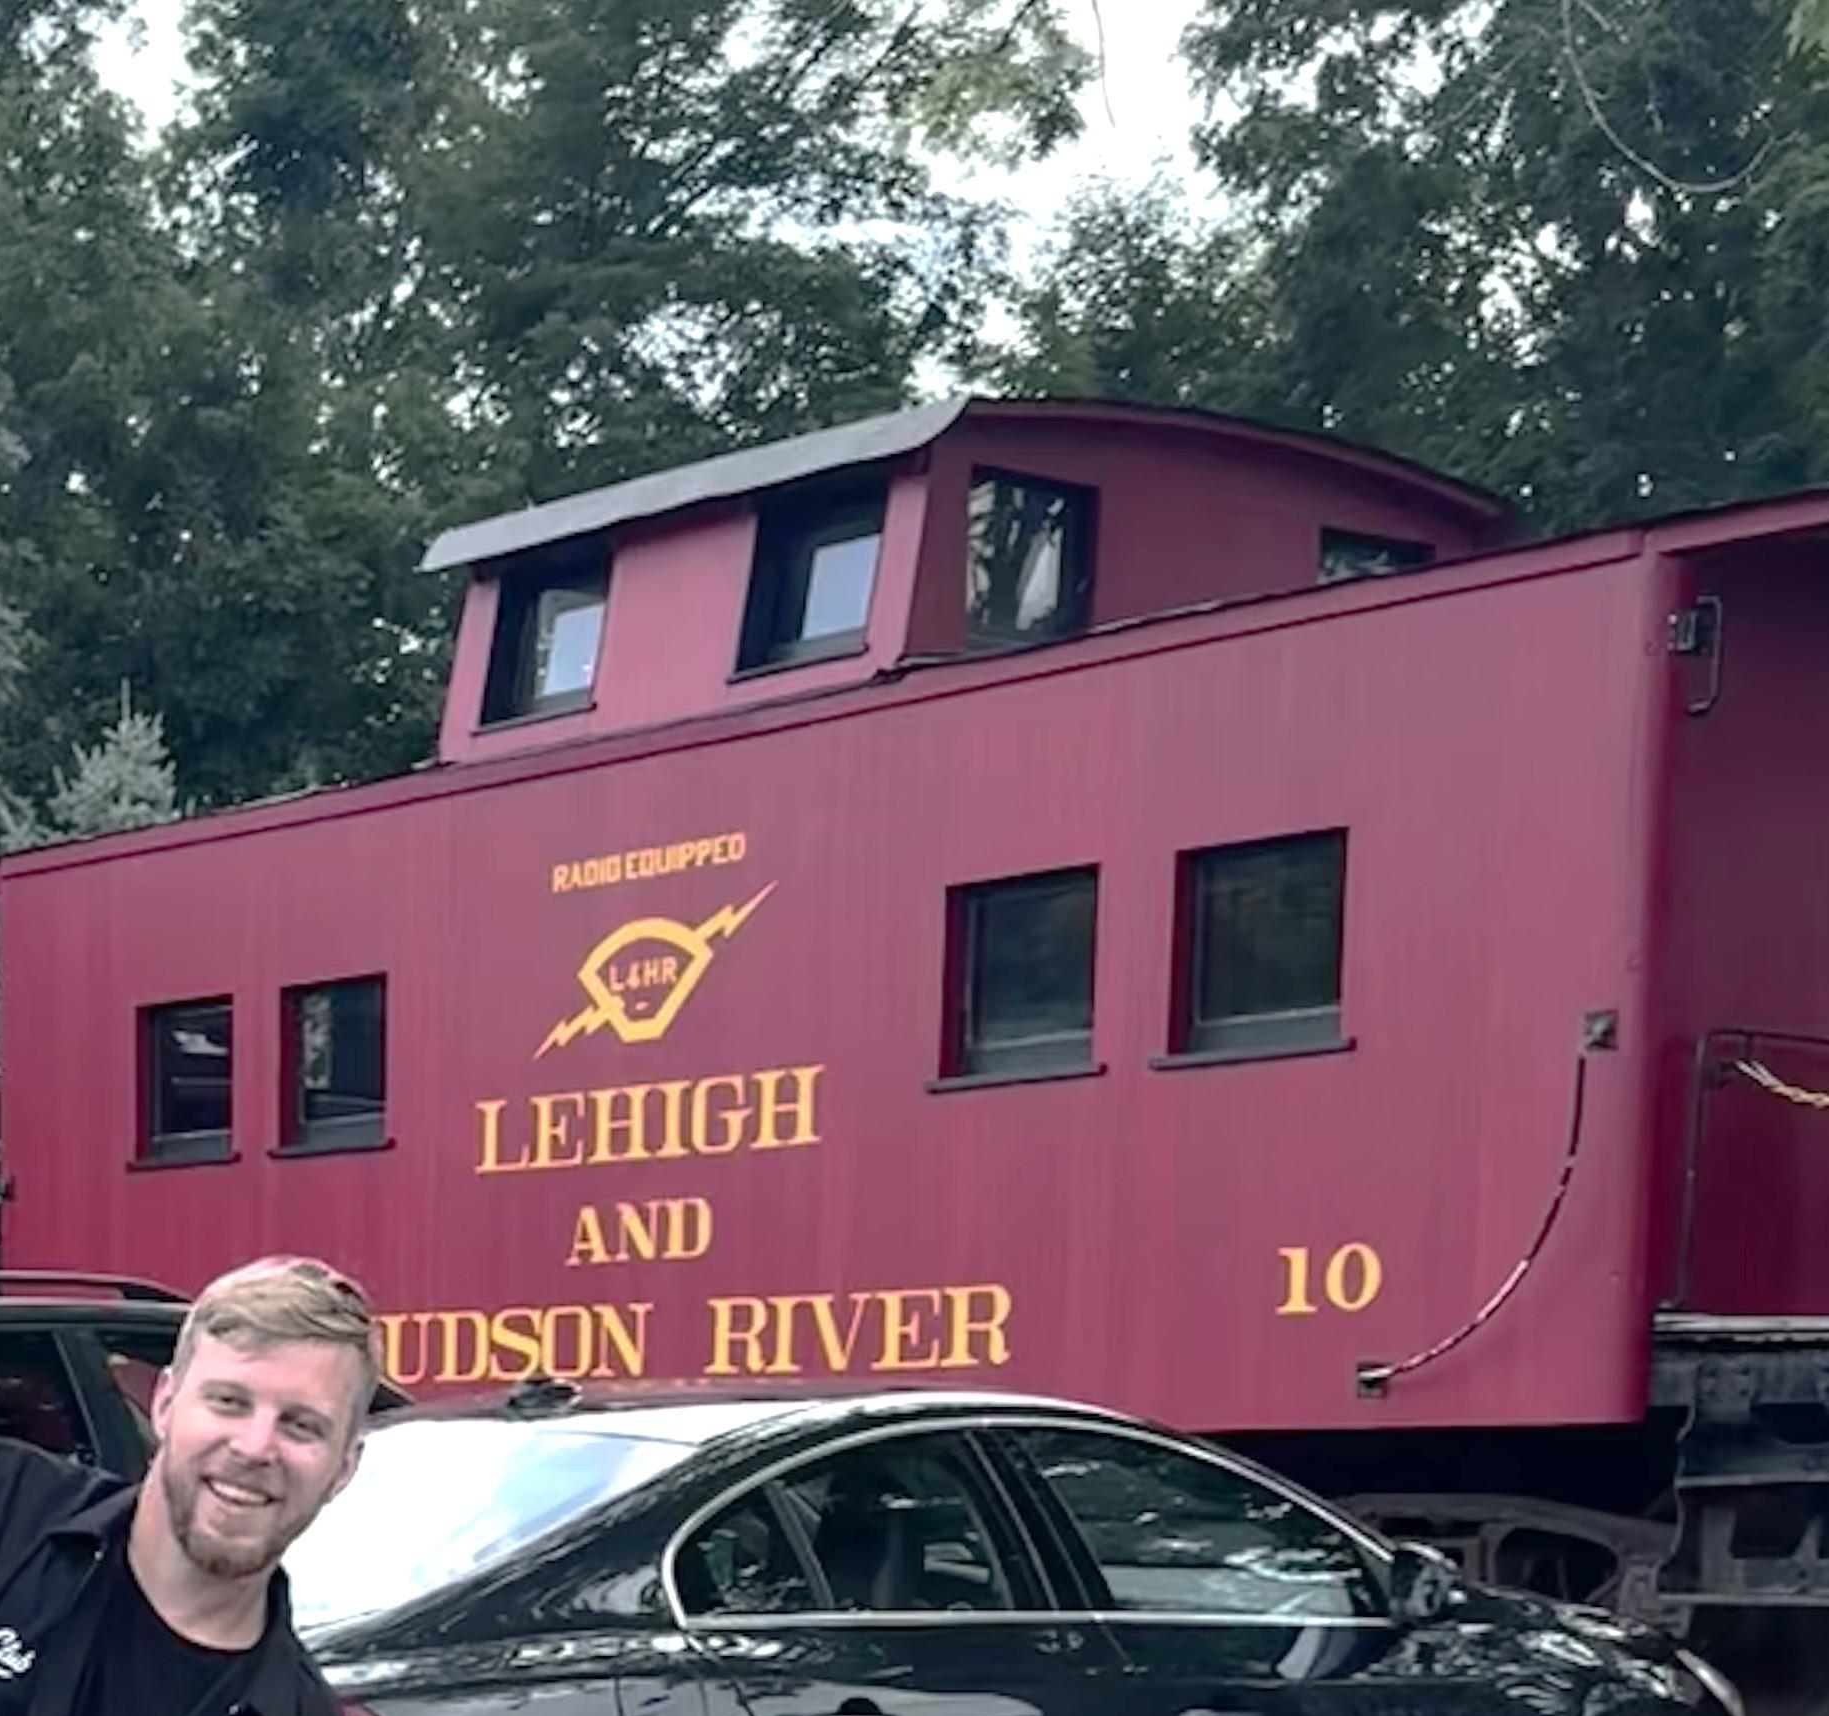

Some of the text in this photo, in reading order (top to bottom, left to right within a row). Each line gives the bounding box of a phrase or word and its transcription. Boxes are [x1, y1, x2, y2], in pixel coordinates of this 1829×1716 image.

[552, 831, 747, 893] RADIO EQUIPPED
[475, 1064, 826, 1175] LEHIGH
[566, 1197, 713, 1267] AND
[1274, 1242, 1384, 1317] 10
[373, 1283, 1013, 1385] UDSON RIVER
